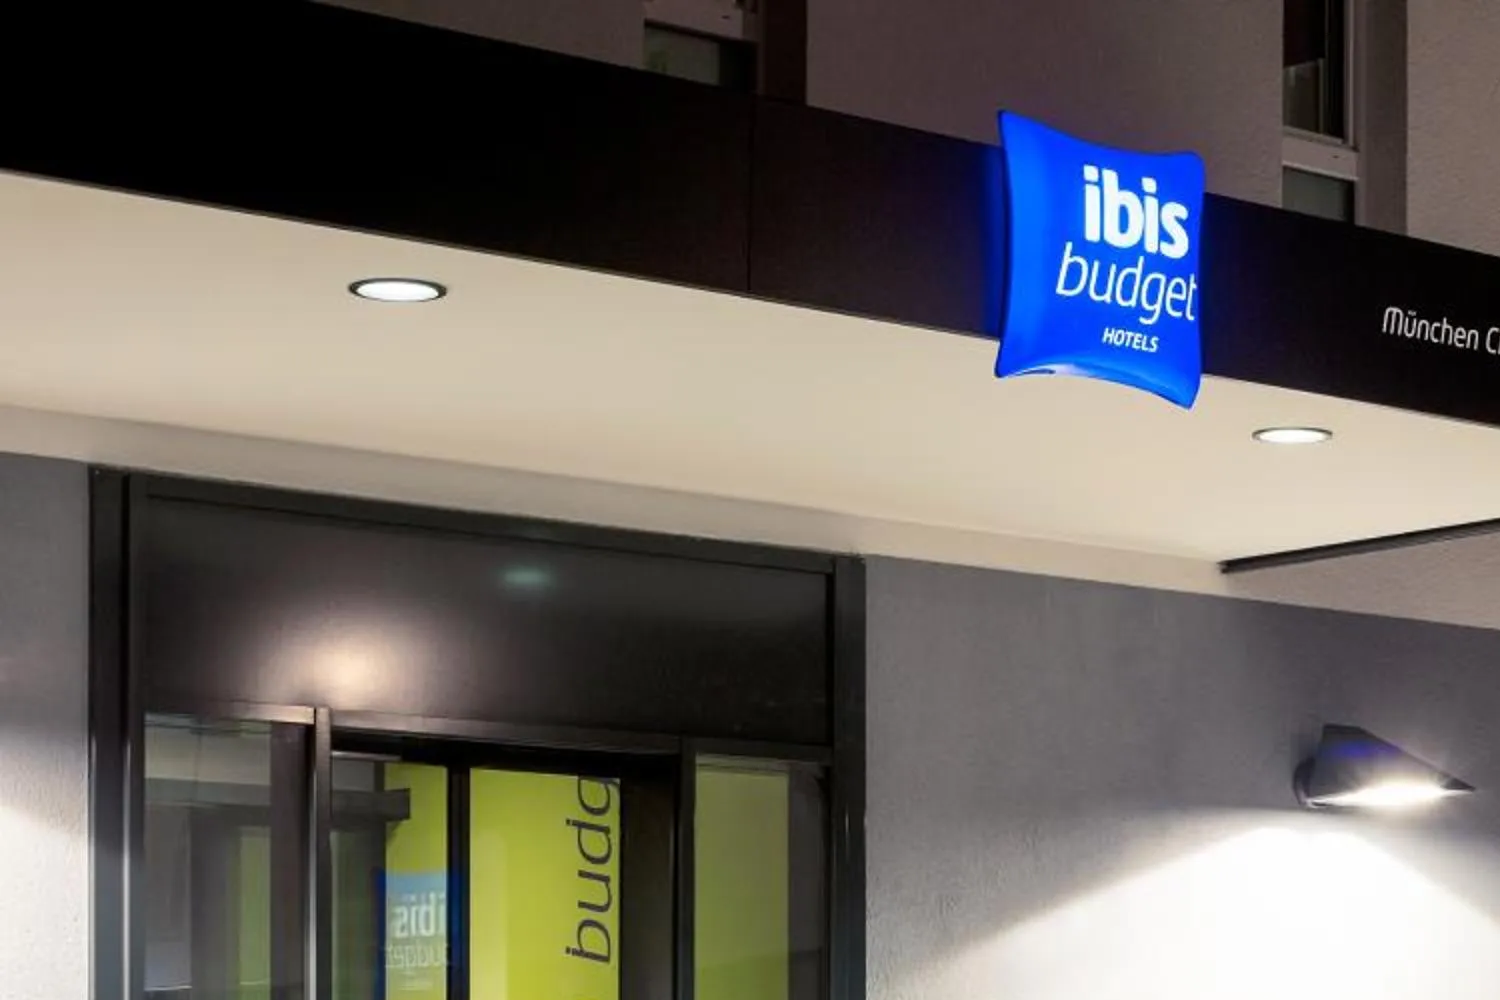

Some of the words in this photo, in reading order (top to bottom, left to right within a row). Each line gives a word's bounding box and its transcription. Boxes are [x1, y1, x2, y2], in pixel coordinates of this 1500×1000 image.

[1083, 164, 1188, 259] ibis
[1055, 241, 1198, 325] budget
[1102, 327, 1159, 353] HOTELS
[1382, 306, 1479, 350] München
